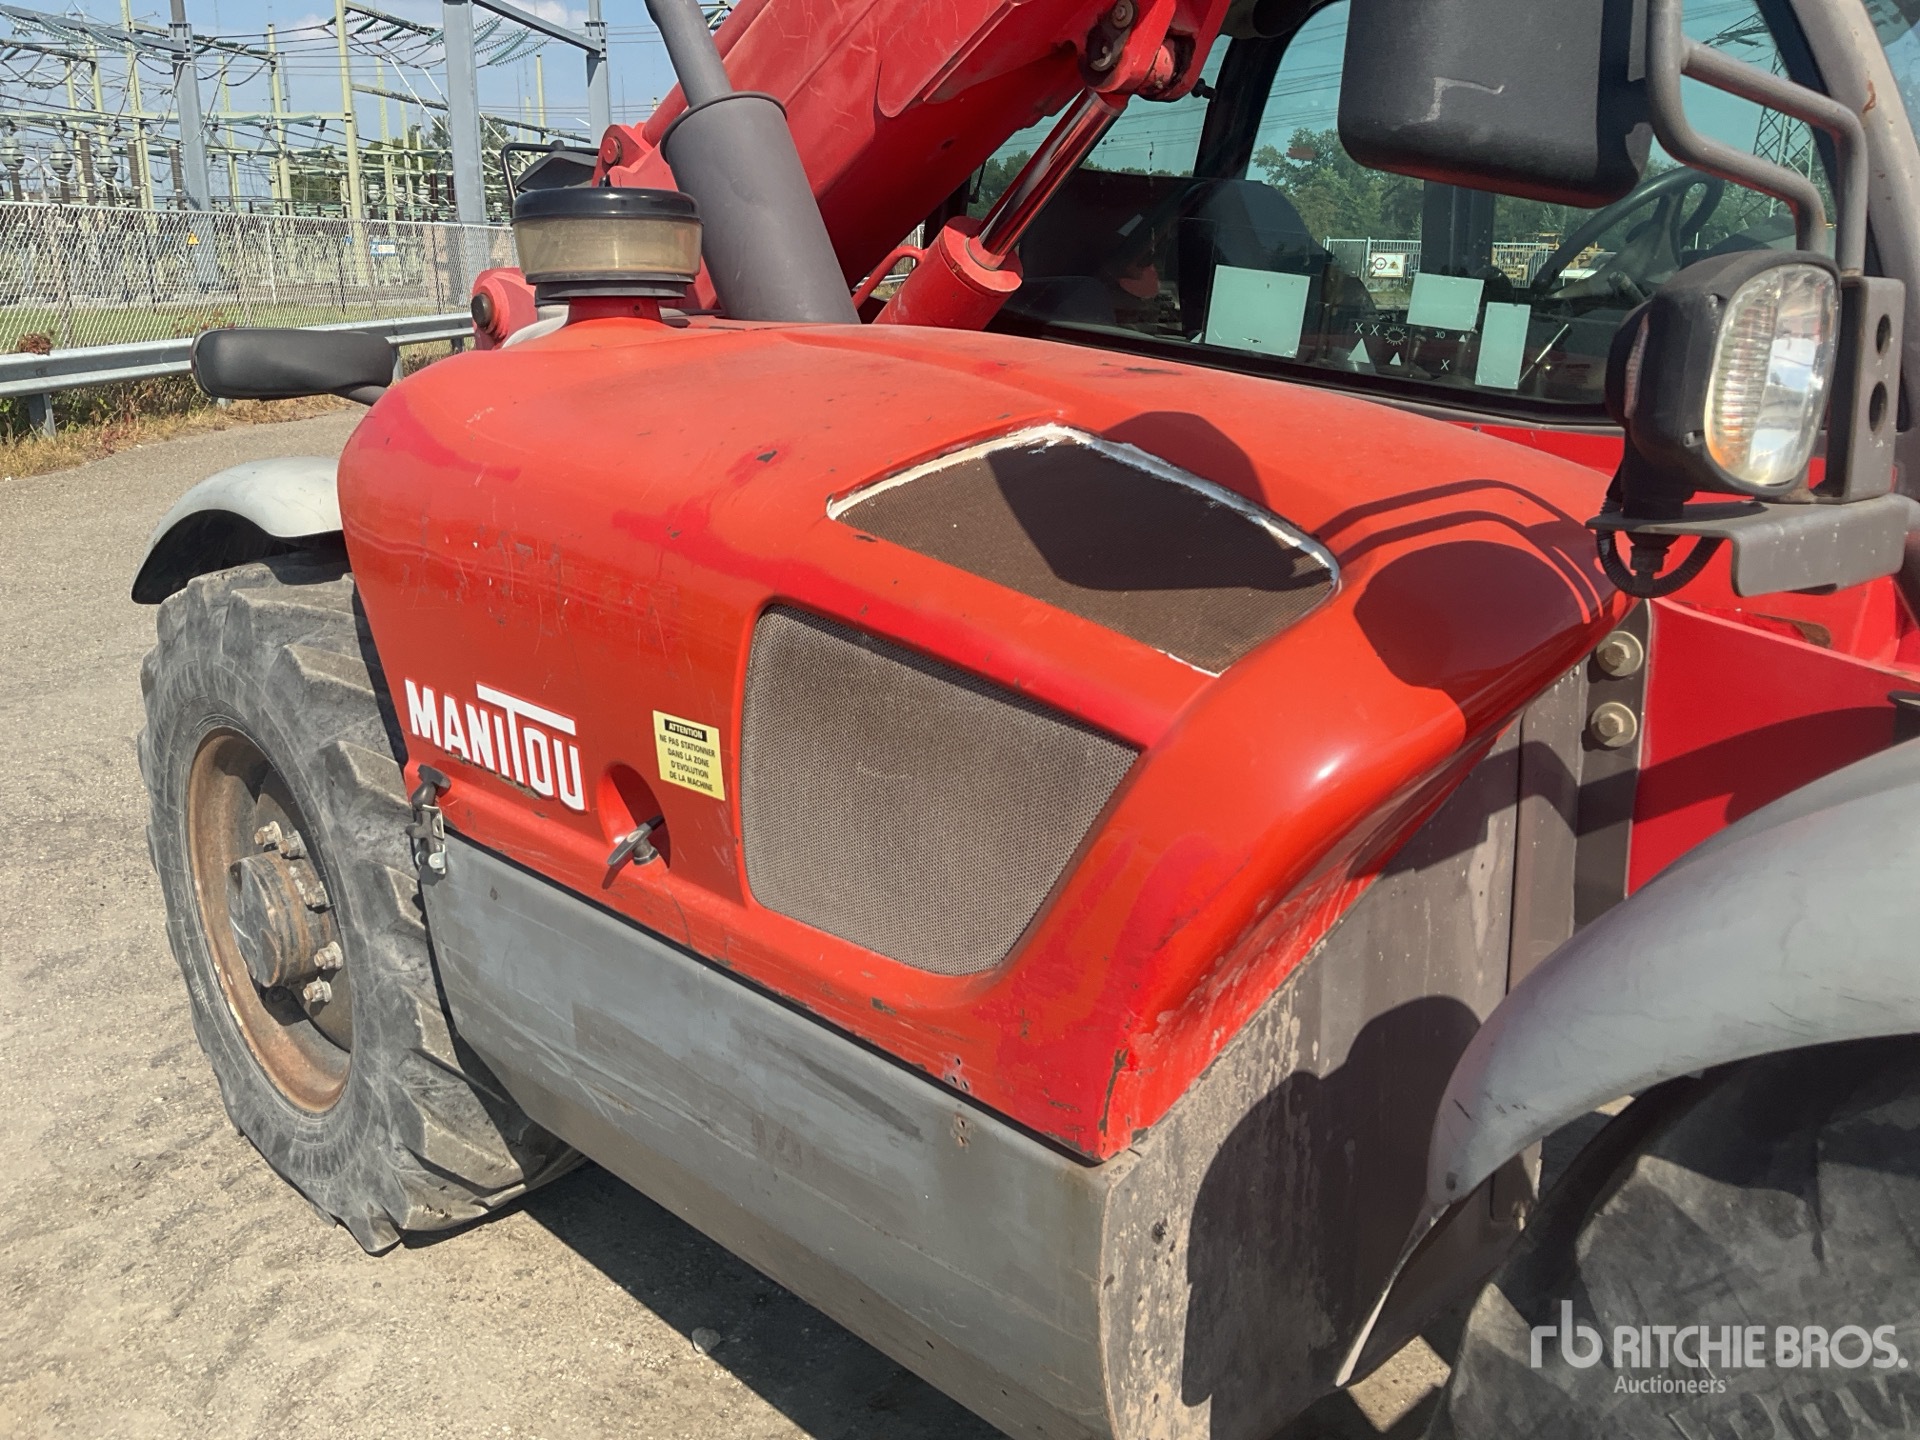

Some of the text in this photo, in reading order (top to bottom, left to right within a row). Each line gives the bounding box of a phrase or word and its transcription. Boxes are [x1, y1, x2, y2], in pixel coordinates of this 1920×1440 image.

[668, 722, 703, 740] ATTENTION
[405, 679, 586, 811] MANITOU
[659, 734, 716, 758] NE PAS STATIONNER
[668, 748, 710, 768] DANS LA ZONE
[671, 760, 709, 779] D'EVOLUTION
[669, 771, 714, 792] DE LA MACHINE
